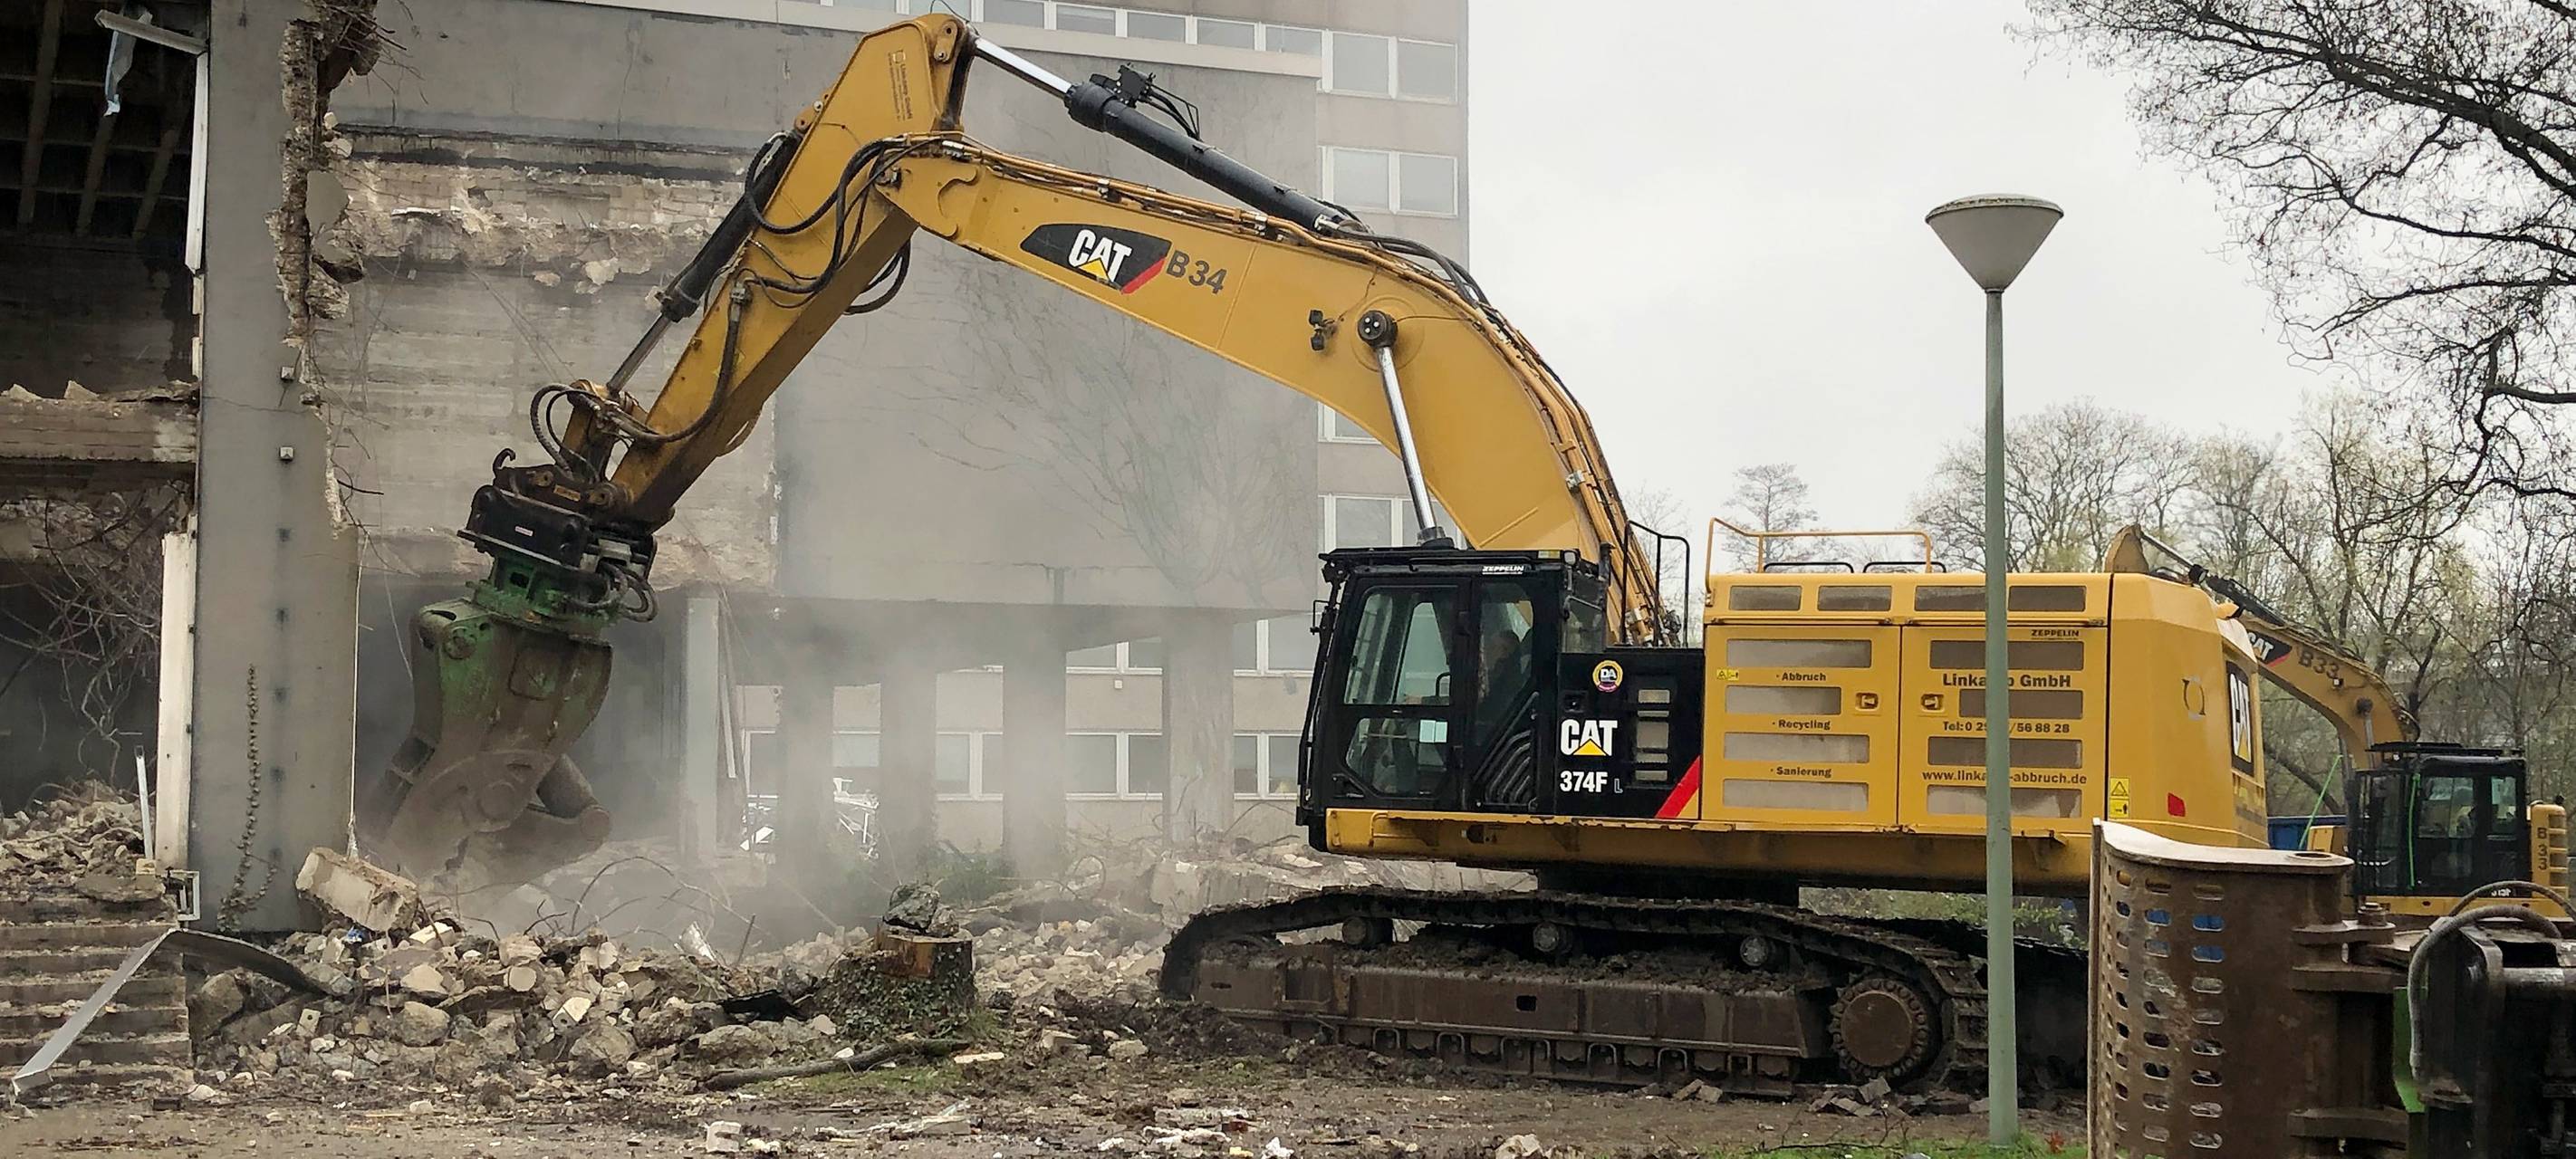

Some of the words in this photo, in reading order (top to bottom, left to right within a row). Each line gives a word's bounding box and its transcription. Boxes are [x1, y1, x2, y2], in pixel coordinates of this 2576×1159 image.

[1069, 229, 1132, 283] CAT
[2031, 629, 2080, 637] ZEPPELIN
[1782, 672, 1827, 682] Abbruch
[1943, 673, 2014, 687] Linka
[2020, 675, 2071, 688] GmbH
[1778, 719, 1831, 731] Recycling
[2034, 723, 2051, 733] 88
[2054, 723, 2071, 733] 28
[1561, 719, 1618, 756] CAT
[1776, 766, 1832, 779] Sanierung
[1560, 771, 1608, 793] 374F
[1614, 778, 1623, 793] L
